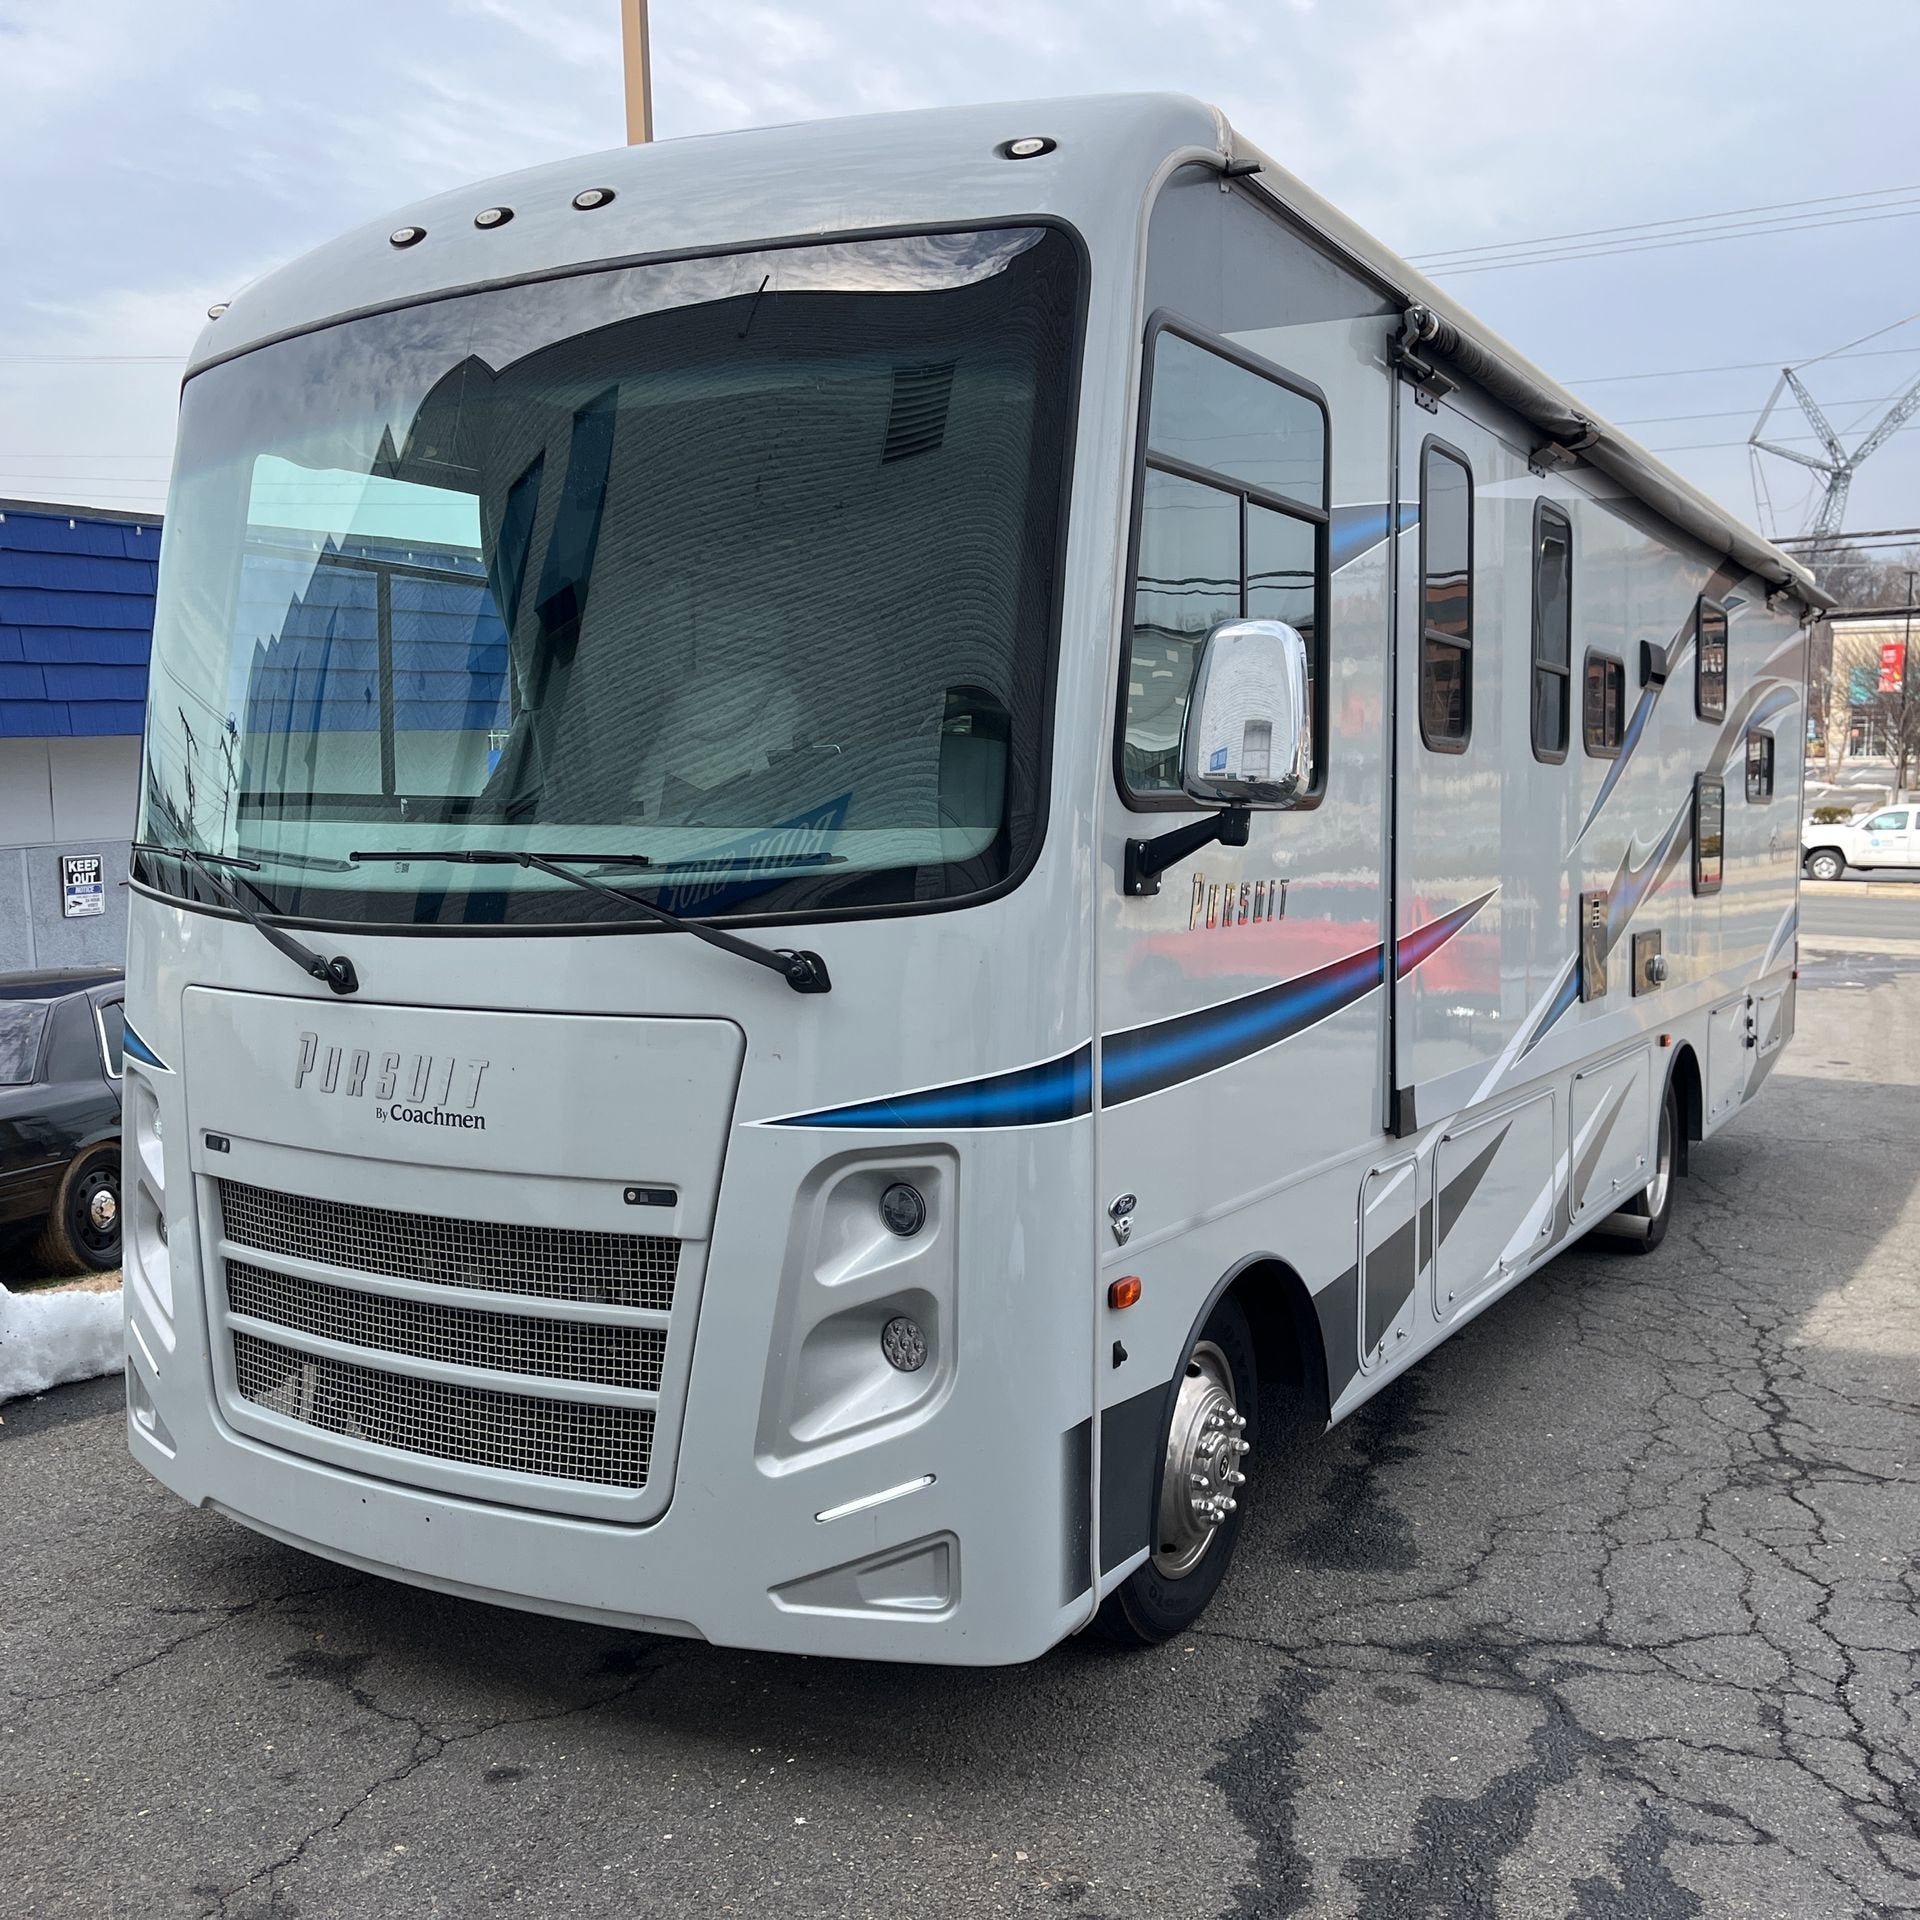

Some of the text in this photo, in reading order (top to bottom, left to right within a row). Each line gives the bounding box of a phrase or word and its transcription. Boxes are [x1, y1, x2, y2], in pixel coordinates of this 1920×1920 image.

[68, 859, 99, 872] KEEP
[73, 872, 96, 884] OUT
[1189, 872, 1290, 931] PURSUIT
[294, 1031, 490, 1108] PURSUIT
[376, 1103, 486, 1130] By Coachmen
